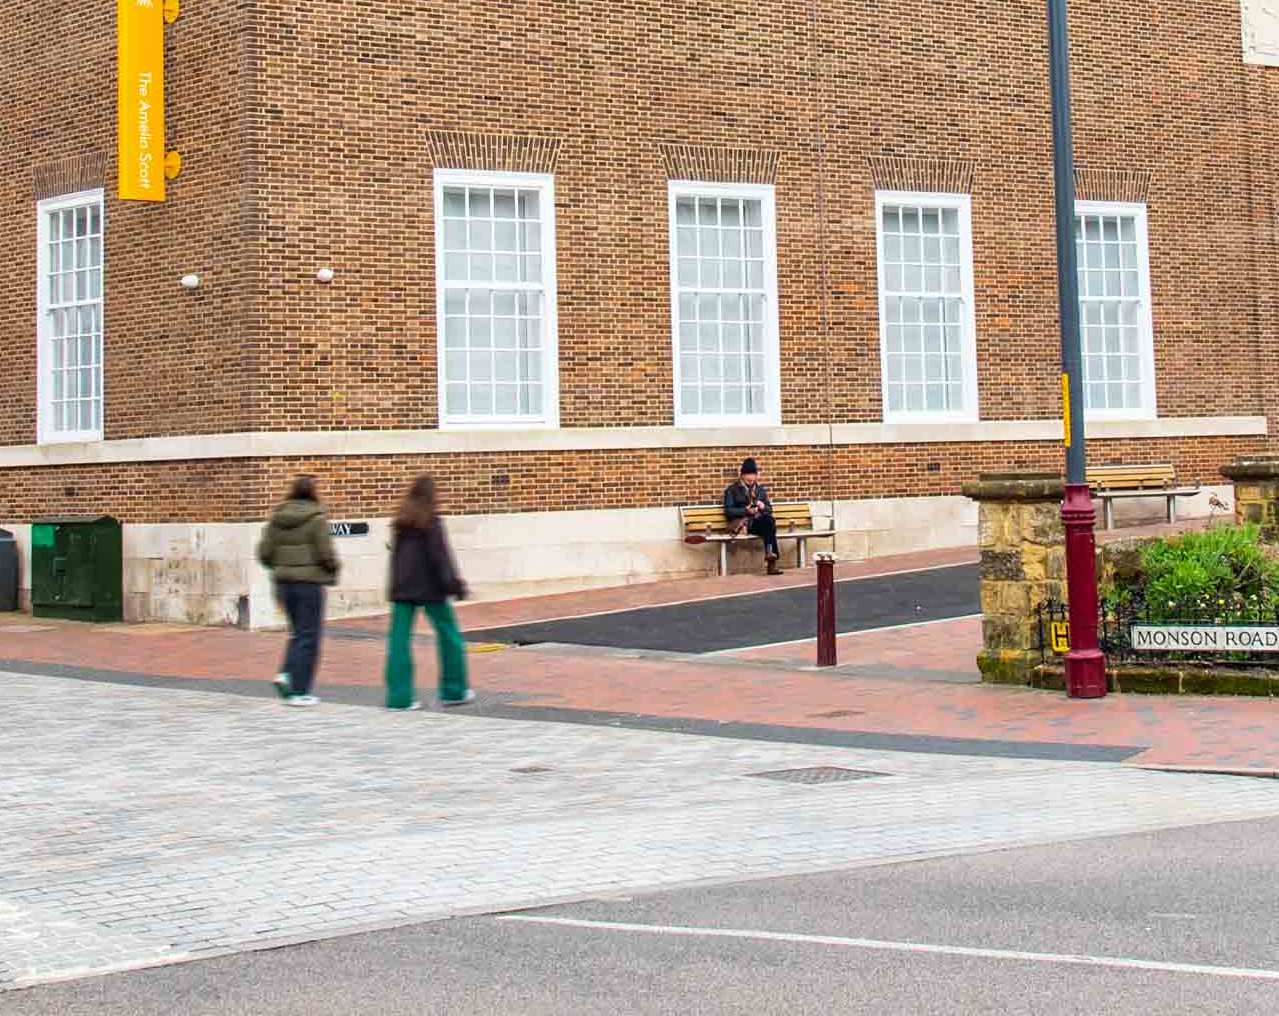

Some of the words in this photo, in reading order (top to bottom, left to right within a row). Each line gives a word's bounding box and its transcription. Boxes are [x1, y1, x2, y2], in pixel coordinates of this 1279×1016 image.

[138, 72, 152, 96] The
[139, 152, 153, 190] Scott
[1054, 624, 1070, 649] H
[1137, 630, 1218, 646] MONSON
[1226, 630, 1278, 646] ROAD
